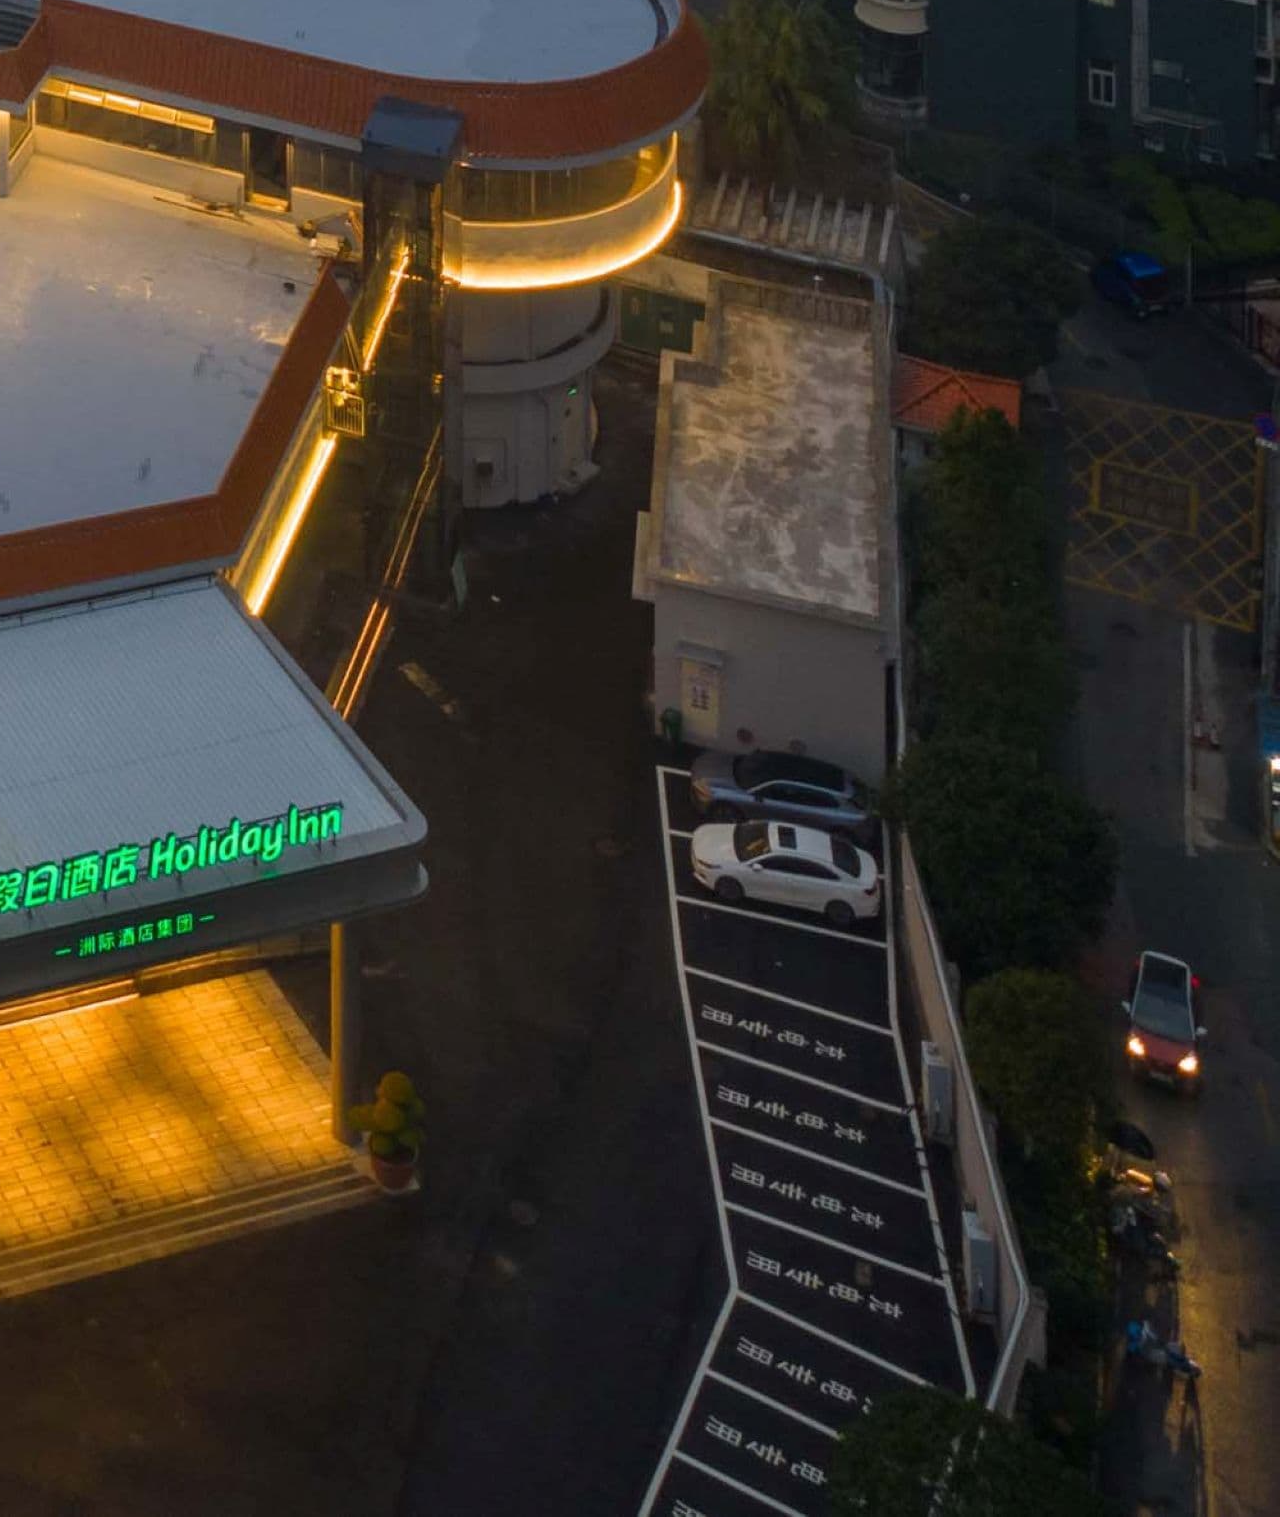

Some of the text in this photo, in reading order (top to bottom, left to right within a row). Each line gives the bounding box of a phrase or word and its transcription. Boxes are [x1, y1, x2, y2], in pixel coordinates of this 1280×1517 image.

[701, 1003, 846, 1061] 充电专用
[717, 1085, 867, 1144] 充电专用
[731, 1162, 884, 1229] 充电专用
[746, 1250, 904, 1319] 充电专用
[705, 1415, 827, 1485] 电专用
